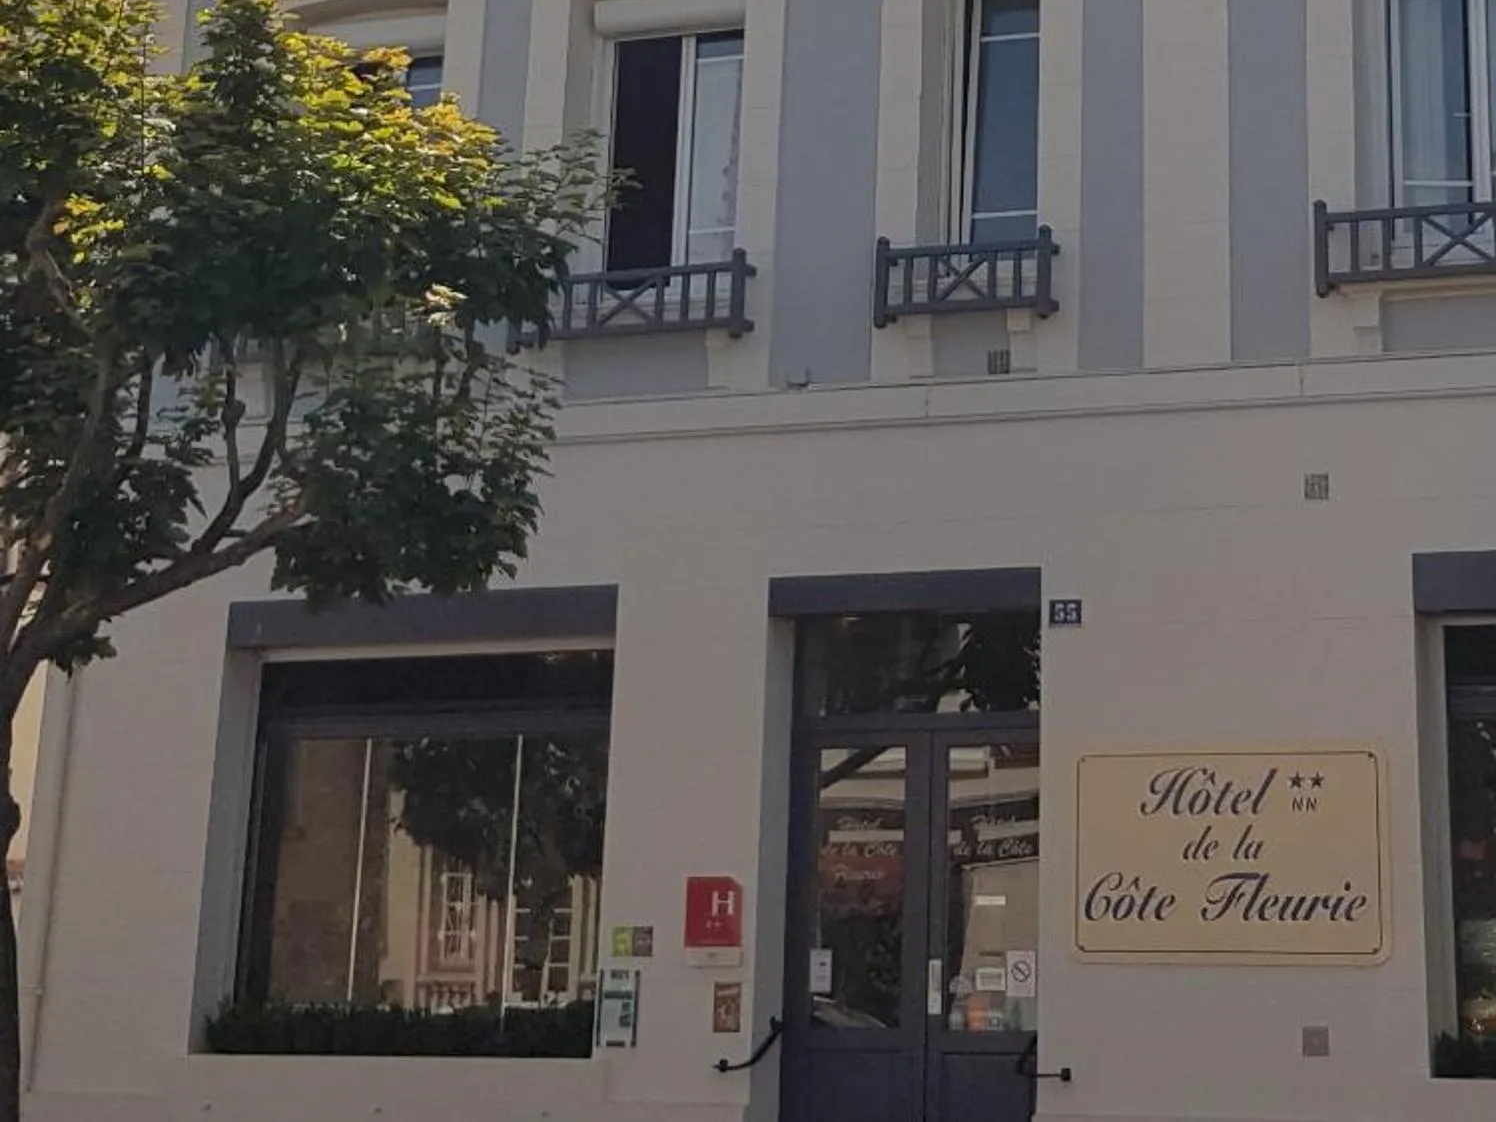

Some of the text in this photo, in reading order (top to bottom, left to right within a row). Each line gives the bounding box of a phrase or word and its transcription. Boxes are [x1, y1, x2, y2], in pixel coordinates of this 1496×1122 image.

[1140, 766, 1278, 817] Hôtel
[1292, 797, 1317, 812] NN
[1182, 824, 1264, 861] de la
[711, 890, 735, 916] H
[1084, 872, 1368, 922] Côte Fleurie
